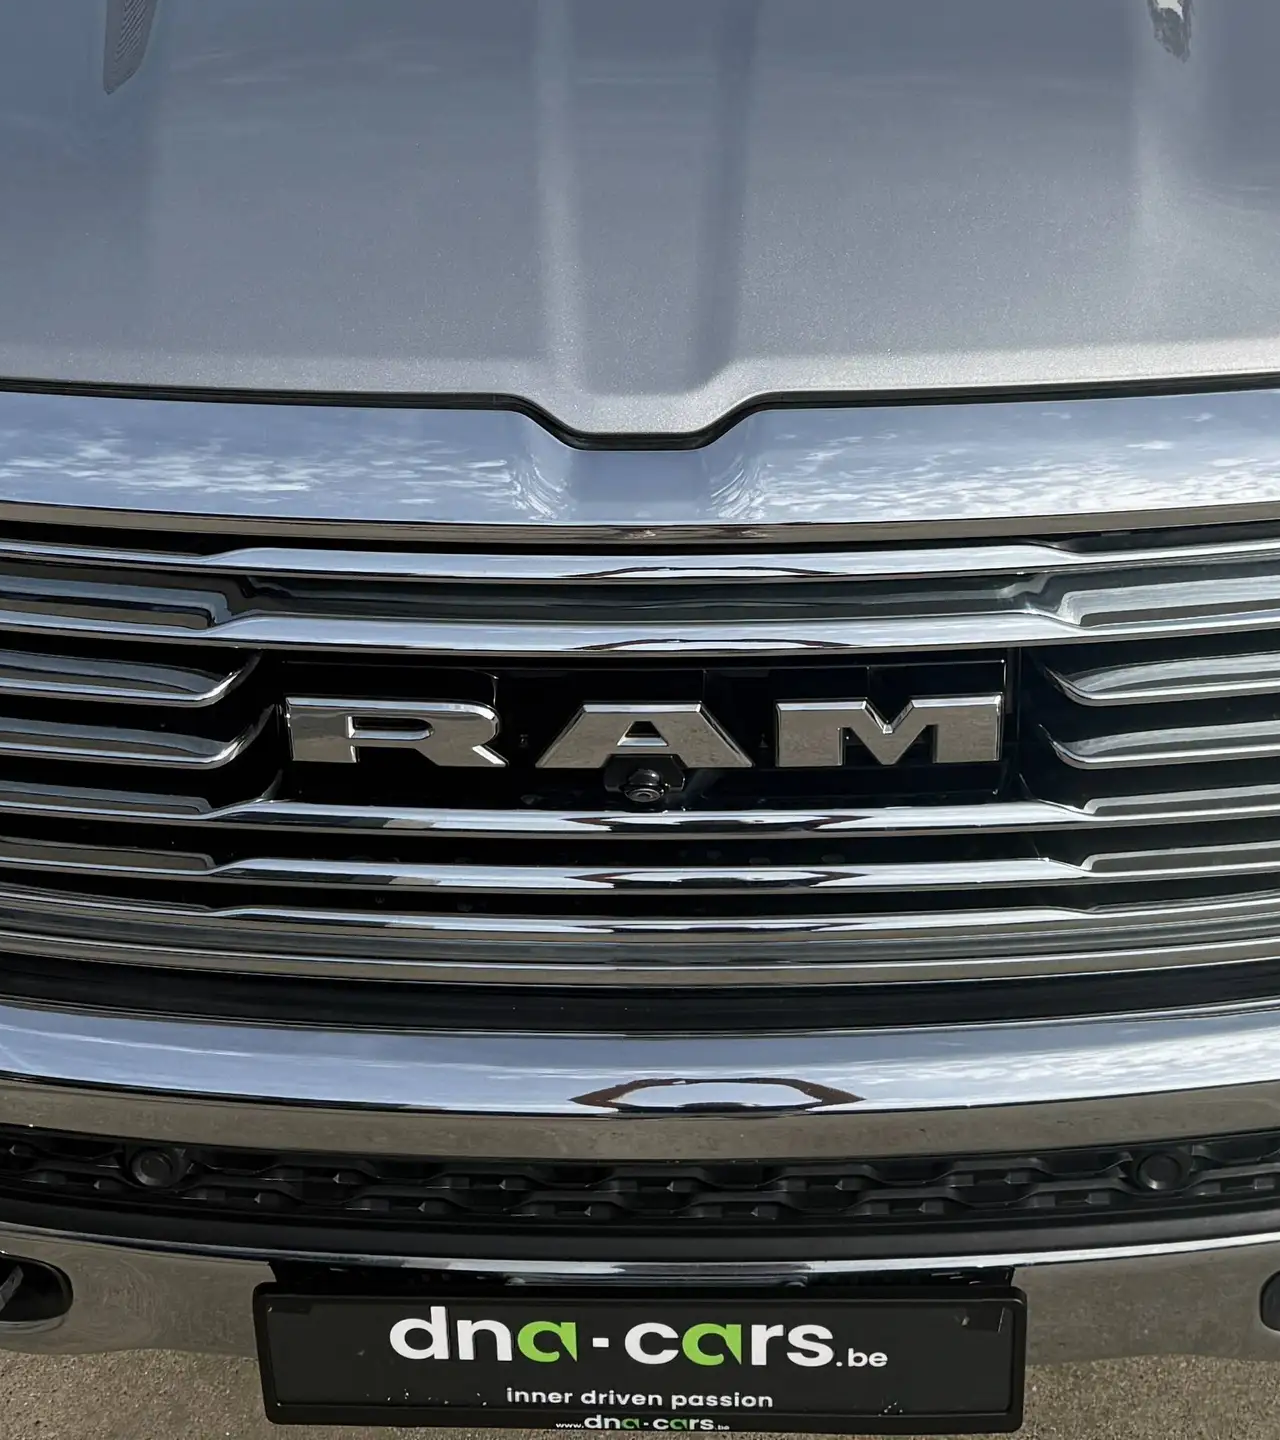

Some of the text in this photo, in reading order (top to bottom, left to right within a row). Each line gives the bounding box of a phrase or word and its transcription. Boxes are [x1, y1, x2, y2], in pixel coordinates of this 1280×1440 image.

[285, 692, 1003, 768] RAM
[506, 1387, 773, 1410] inner driven passion
